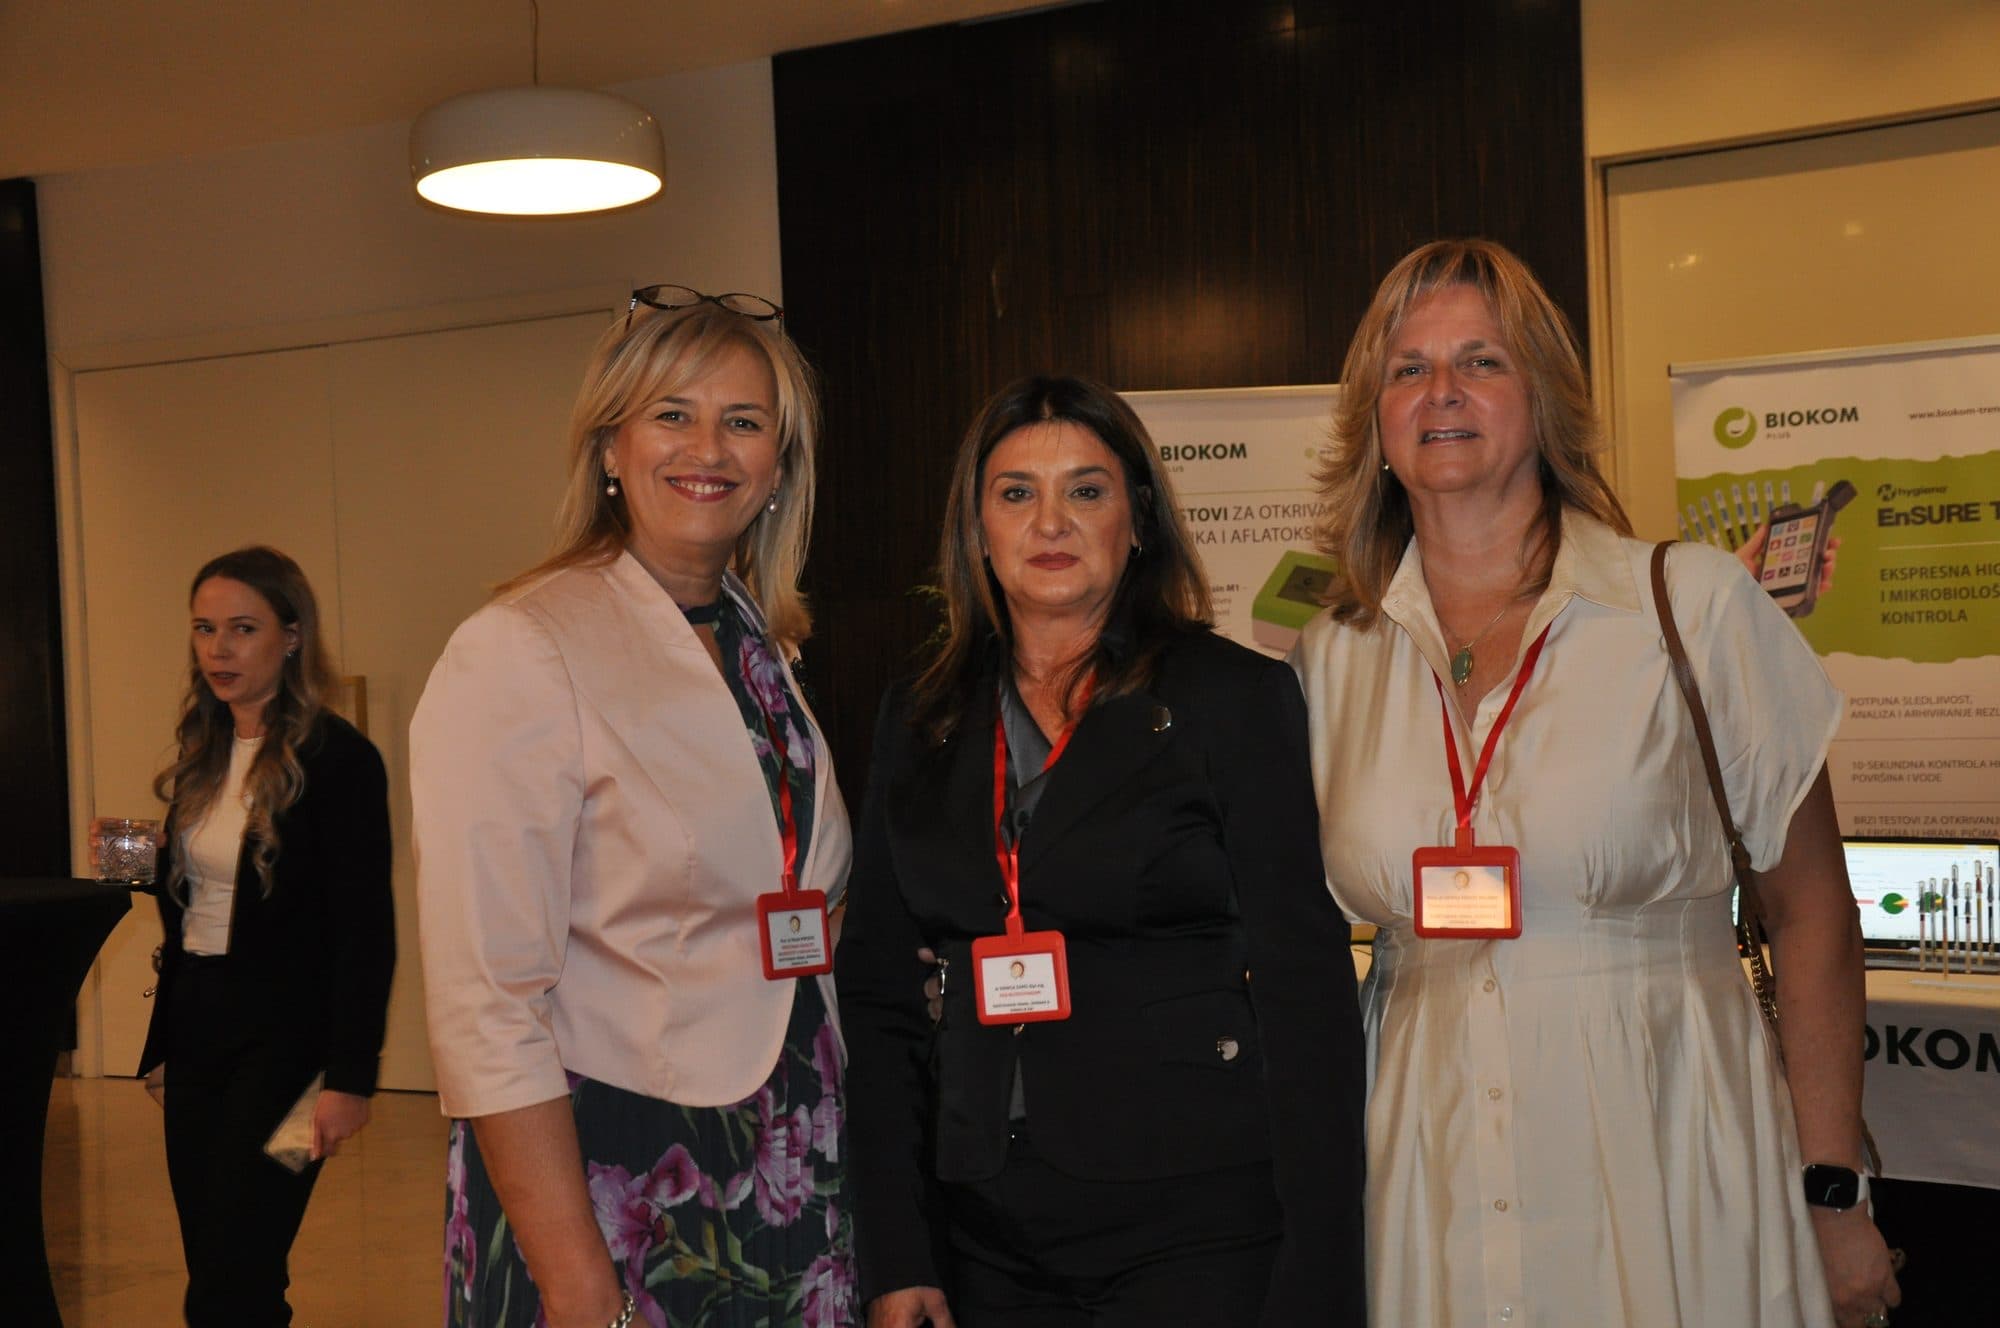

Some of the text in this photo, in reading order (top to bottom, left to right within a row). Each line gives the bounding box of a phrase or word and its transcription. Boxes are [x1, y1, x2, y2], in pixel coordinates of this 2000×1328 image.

[1766, 406, 1859, 428] BIOKOM
[1160, 443, 1247, 461] BIOKOM
[1232, 504, 1254, 520] ZA
[1877, 502, 1982, 527] EnSURE
[1222, 529, 1226, 544] I
[1880, 564, 1971, 581] EKSPRESNA
[1880, 590, 1885, 602] I
[1881, 608, 1968, 624] KONTROLA
[1850, 696, 1900, 706] POTPUNA
[1850, 709, 1896, 719] ANALIZA
[1904, 708, 1972, 719] ARHIVIRANJE
[1928, 759, 1986, 769] KONTROLA
[1852, 771, 1904, 783] POVRŠINA
[1912, 773, 1943, 783] VODE
[1879, 815, 1920, 825] TESTOVI
[1923, 815, 1937, 825] ZA
